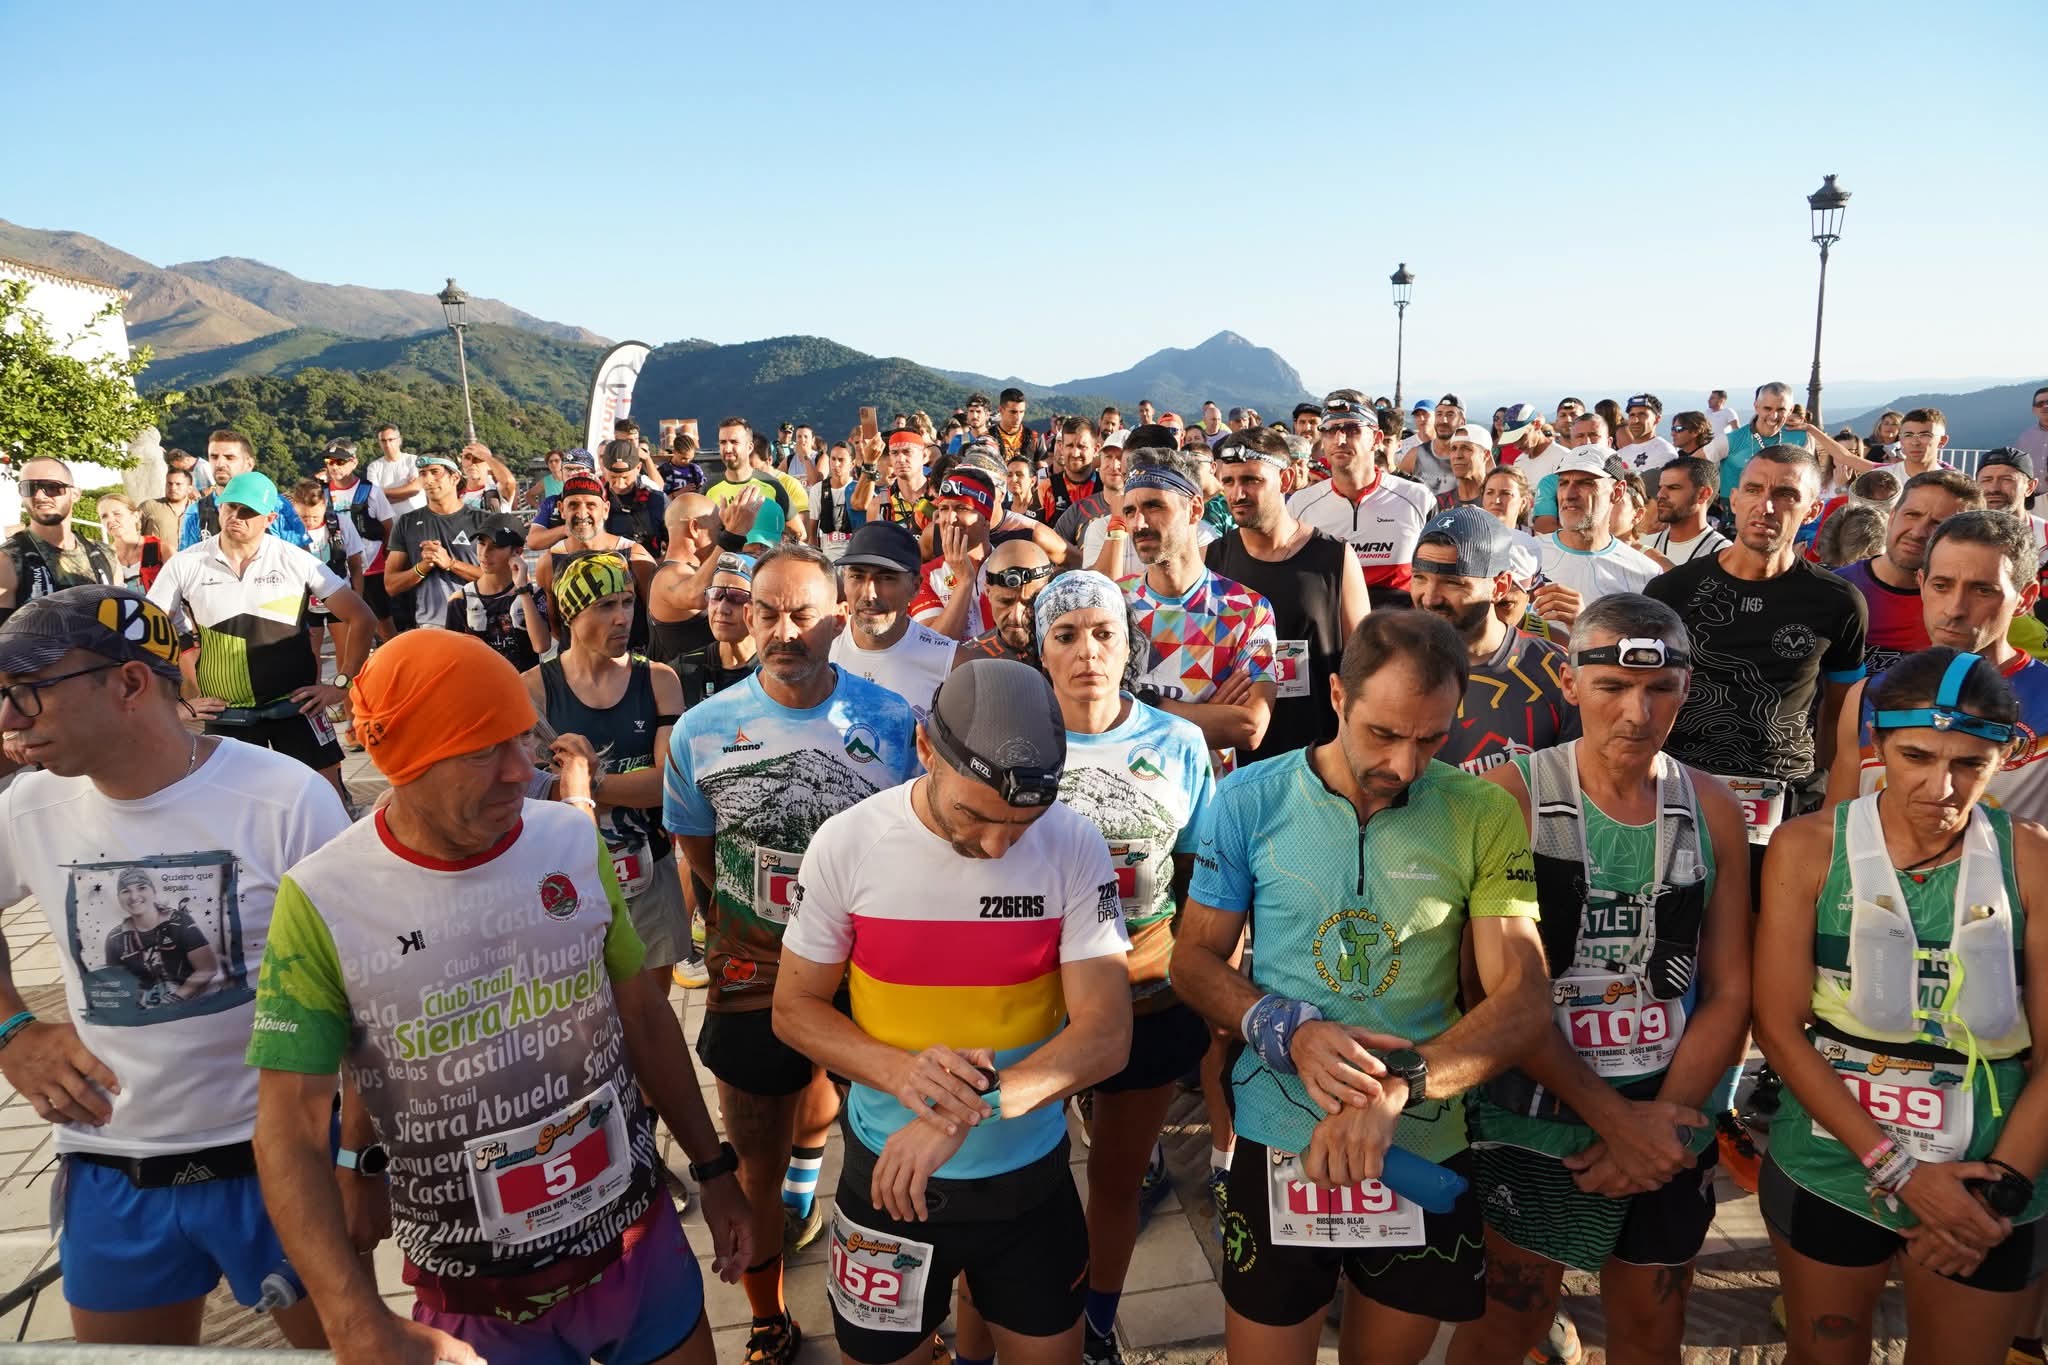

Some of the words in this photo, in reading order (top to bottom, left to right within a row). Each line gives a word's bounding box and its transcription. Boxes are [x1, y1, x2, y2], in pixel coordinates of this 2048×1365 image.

[722, 742, 761, 753] Vulkano
[970, 758, 991, 778] PETZL
[161, 873, 195, 882] Quiero
[196, 872, 214, 881] que
[980, 895, 1044, 918] 226ERS
[424, 986, 469, 1018] Club
[472, 967, 513, 1001] Trail
[395, 1003, 503, 1060] Sierra
[1575, 1006, 1667, 1046] 109
[437, 1019, 574, 1087] Castillejos
[395, 1111, 469, 1144] Sierra
[475, 1073, 569, 1133] Abuela
[410, 1098, 438, 1116] Club
[440, 1086, 478, 1112] Trail
[543, 1152, 577, 1196] 5
[527, 1205, 552, 1219] ATIENZA
[570, 1185, 593, 1200] MANUEL
[1291, 1178, 1393, 1212] 119
[1347, 1217, 1365, 1225] ALEJO
[833, 1244, 899, 1306] 152
